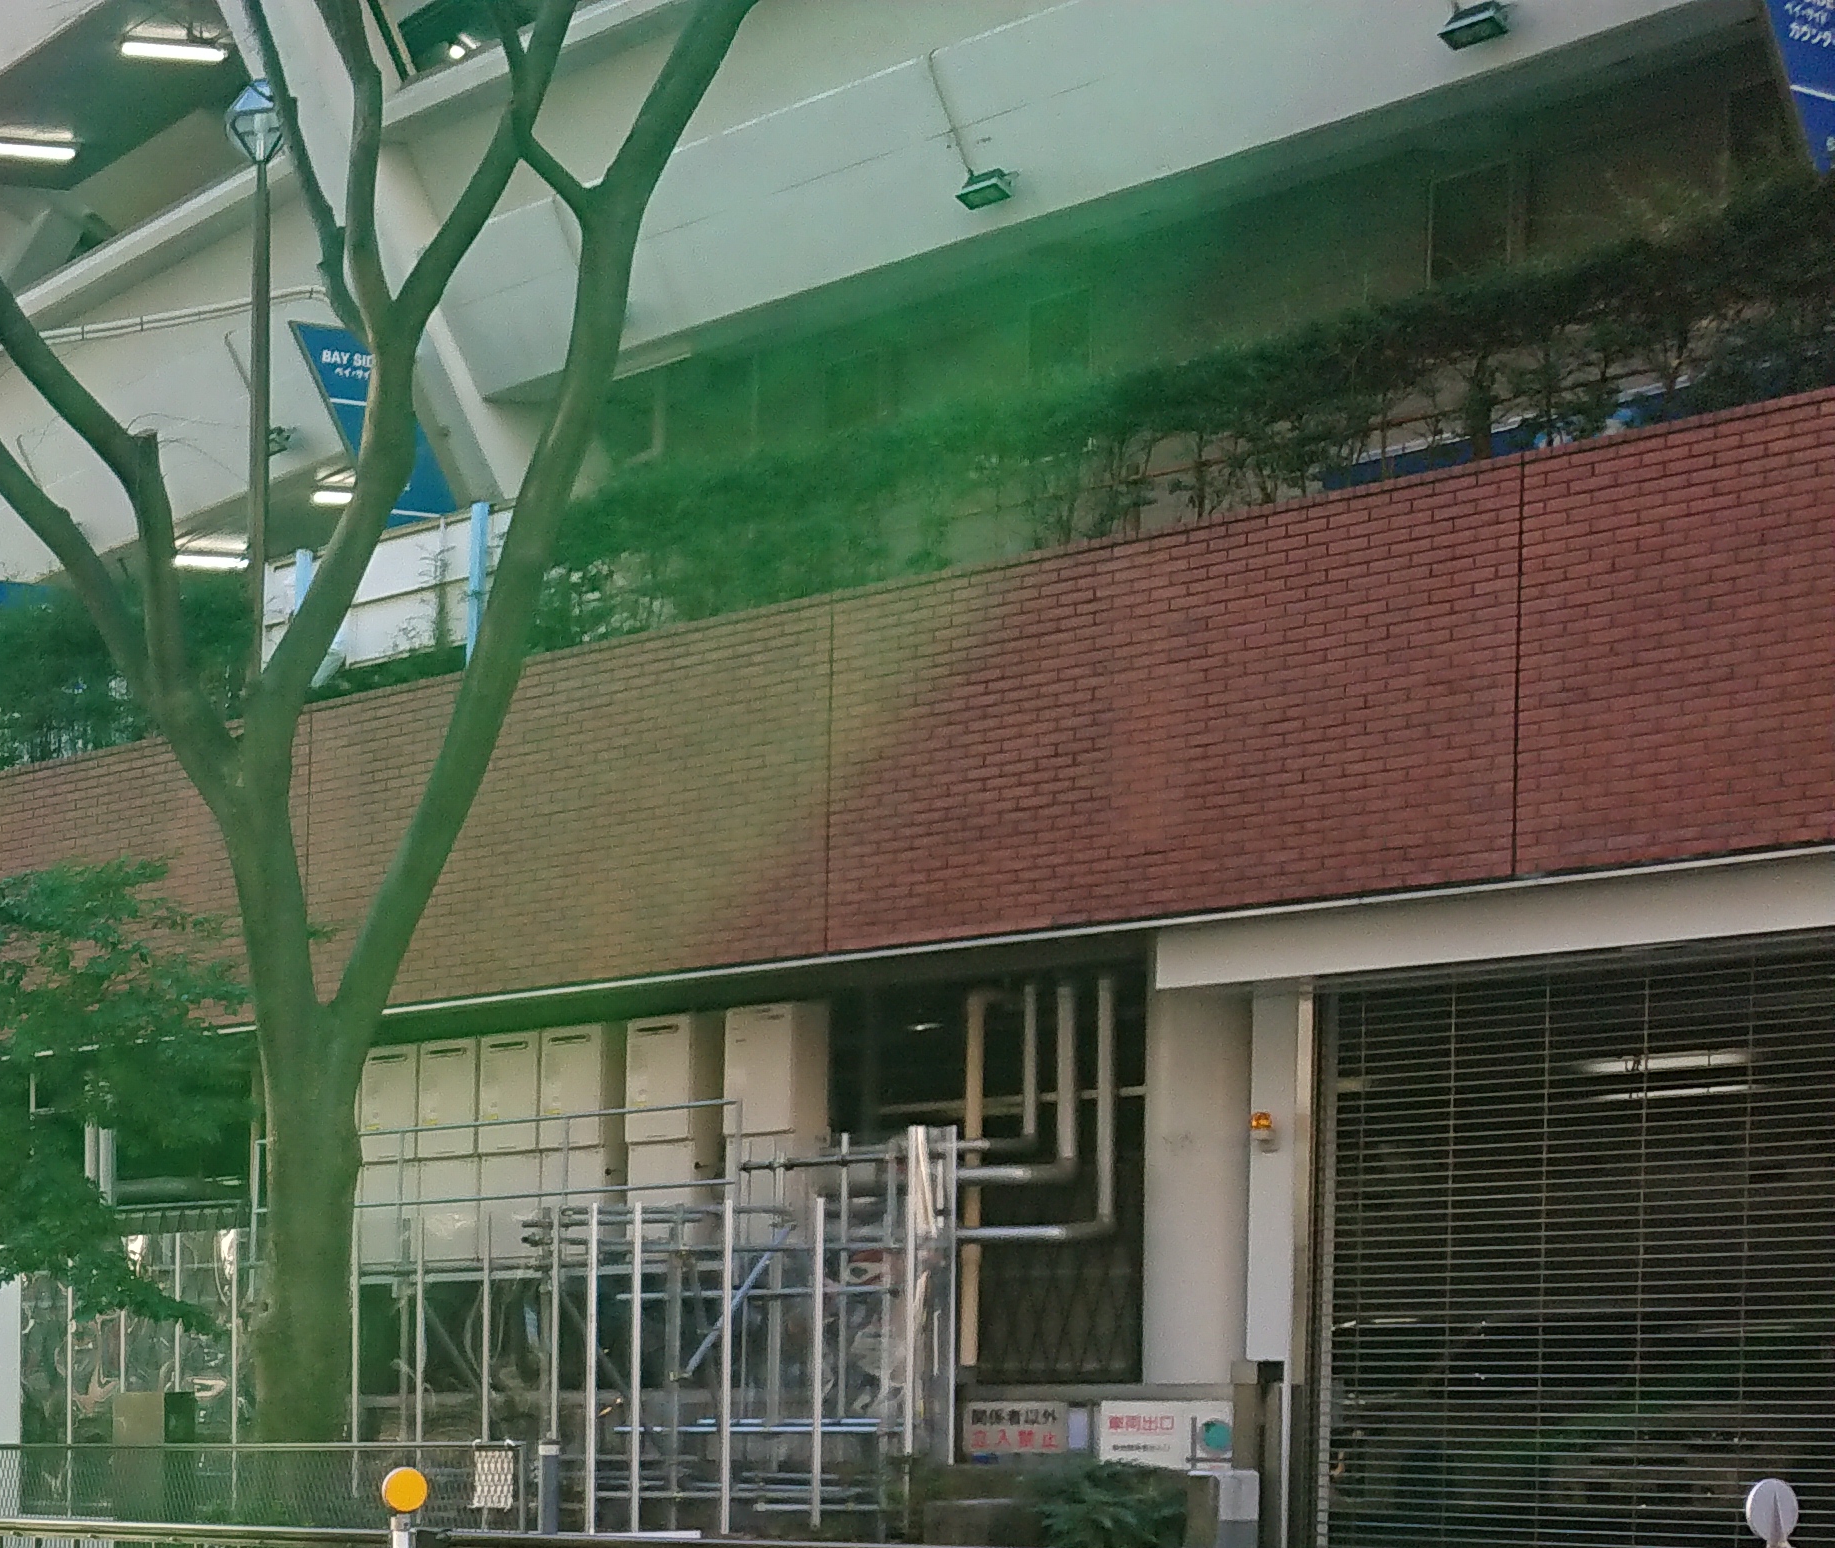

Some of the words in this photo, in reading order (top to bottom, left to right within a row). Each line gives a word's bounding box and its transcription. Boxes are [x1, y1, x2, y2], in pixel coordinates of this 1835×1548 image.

[321, 349, 350, 364] BAY
[970, 1429, 1059, 1449] 立入禁止
